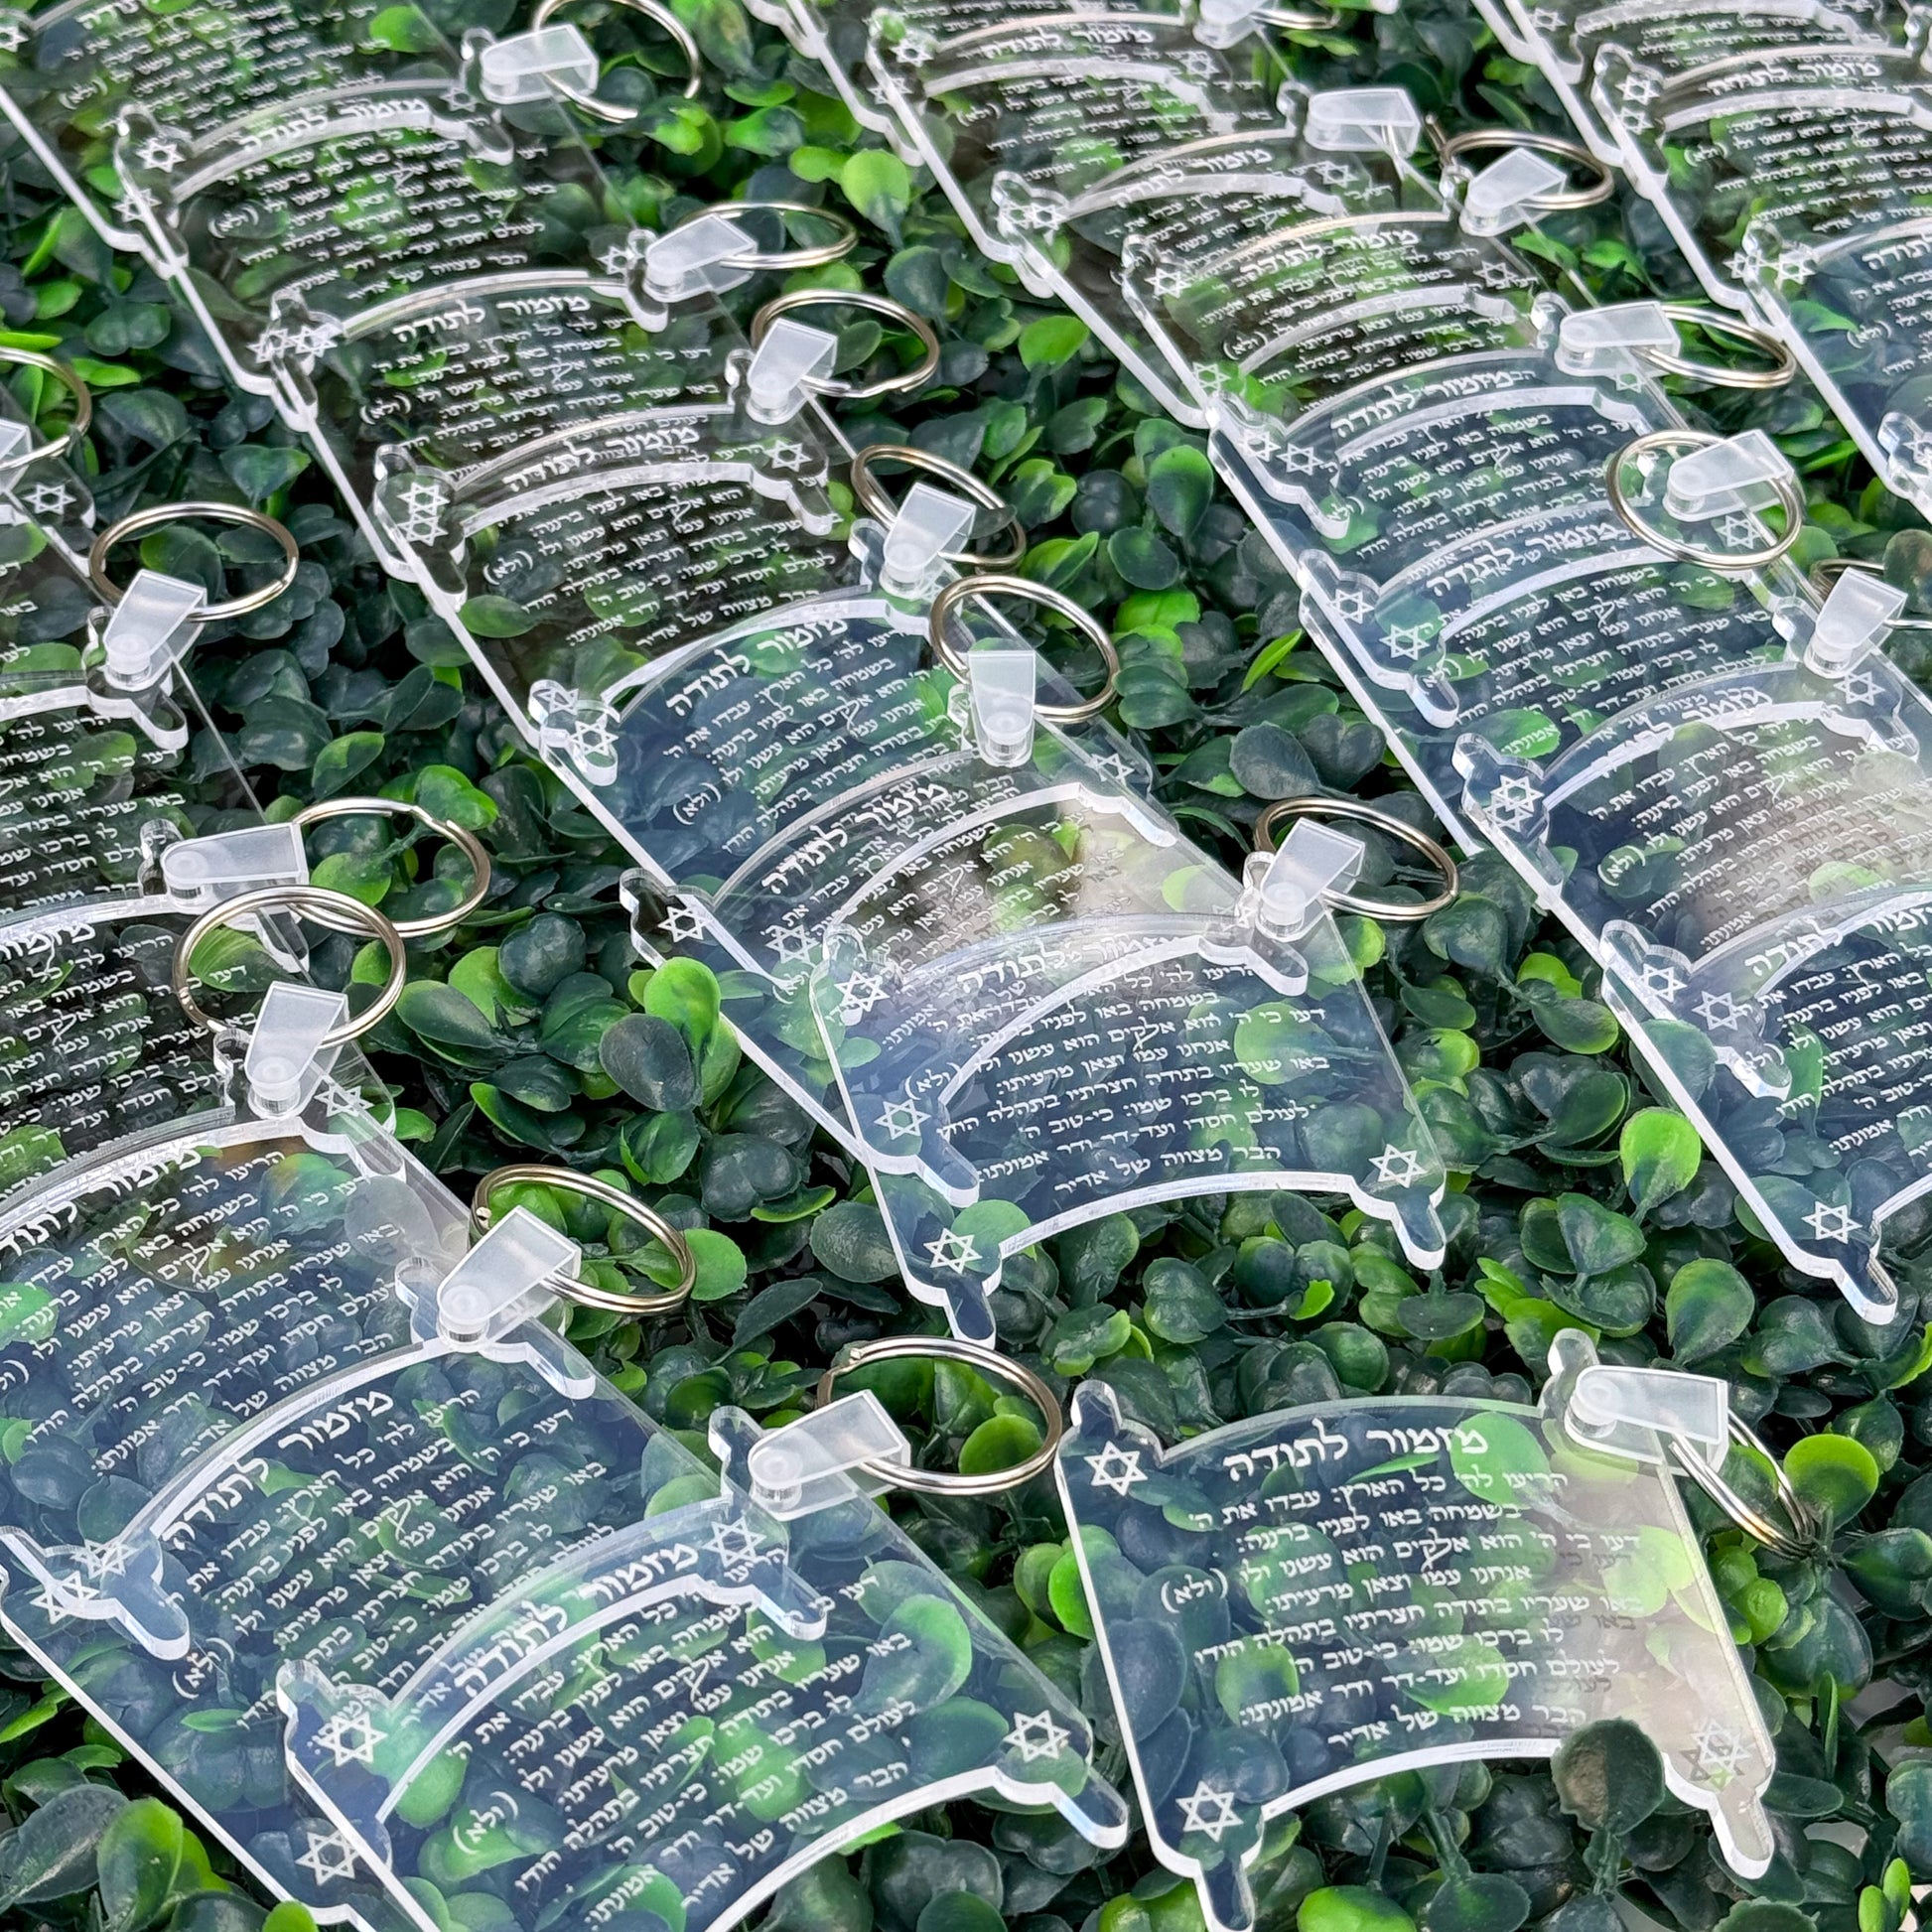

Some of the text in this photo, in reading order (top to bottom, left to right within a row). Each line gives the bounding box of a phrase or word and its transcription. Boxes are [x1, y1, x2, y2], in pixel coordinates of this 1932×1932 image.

[1588, 565, 1660, 593] בשמחה
[1509, 593, 1551, 620] לפניו
[1553, 585, 1588, 604] באו
[664, 616, 849, 717] מזמור לתודה
[828, 657, 897, 692] בשמחה
[796, 686, 831, 708] באו
[52, 714, 111, 734] הריעו
[756, 700, 796, 731] לפניו
[1725, 730, 1760, 747] כל
[140, 749, 178, 764] דעו
[1634, 766, 1677, 794] עבדו
[74, 792, 185, 819] באו שעריו
[1607, 789, 1638, 813] את
[980, 841, 1015, 864] הוא
[985, 860, 1035, 889] אנחנו
[111, 934, 175, 959] הריעו
[49, 969, 137, 1005] בשמחה
[1837, 977, 1883, 1006] לפניו
[1886, 971, 1926, 990] באו
[100, 992, 141, 1015] הוא
[1817, 1003, 1904, 1041] הוא עשנו
[1132, 1046, 1169, 1062] עמו
[1174, 1038, 1231, 1058] אנחנו
[1079, 1052, 1125, 1080] וצאן
[986, 1055, 1329, 1123] באו שעריו בתודה חצרתיו בתהלה
[1774, 1063, 1886, 1117] בתהלה הודו
[233, 1238, 293, 1272] אנחנו
[192, 1267, 232, 1292] עמו
[317, 1272, 344, 1293] לו
[143, 1289, 192, 1327] וצאן
[263, 1289, 319, 1320] ברכו
[179, 1332, 394, 1458] הבר מצווה של אדיר
[418, 1388, 482, 1426] הריעו
[333, 1447, 377, 1470] כל
[1222, 1417, 1489, 1482] מזמור לתודה
[160, 1390, 394, 1552] מזמור לתודה
[1408, 1467, 1448, 1493] כל
[1501, 1472, 1569, 1489] הריעו
[1220, 1501, 1259, 1526] את
[1263, 1489, 1321, 1513] עבדו
[1428, 1502, 1524, 1523] בשמחה
[1315, 1505, 1371, 1539] לפניו
[1379, 1507, 1424, 1528] באו
[218, 1518, 273, 1561] עבדו
[1479, 1533, 1523, 1551] הוא
[1565, 1533, 1591, 1549] כי
[1598, 1534, 1641, 1551] דעו
[1278, 1552, 1332, 1579] עשנו
[1340, 1544, 1386, 1566] הוא
[184, 1560, 223, 1594] את
[577, 1543, 700, 1602] מזמור
[1239, 1557, 1272, 1584] ולו
[1420, 1569, 1461, 1587] עמו
[1468, 1565, 1533, 1586] אנחנו
[1360, 1573, 1412, 1603] וצאן
[1193, 1595, 1644, 1665] באו שעריו בתודה חצרתיו בתהלה הודו
[1473, 1627, 1534, 1648] ברכו
[1539, 1616, 1565, 1644] לו
[734, 1650, 797, 1689] אנחנו
[1475, 1660, 1538, 1679] חסדו
[1545, 1648, 1621, 1678] לעולם
[690, 1684, 734, 1713] עמו
[824, 1690, 853, 1714] לו
[1329, 1679, 1375, 1700] ודר
[639, 1710, 690, 1754] וצאן
[767, 1710, 826, 1746] ברכו
[1326, 1703, 1587, 1748] הבר מצווה של אדיר
[513, 1631, 911, 1892] באו שעריו בתודה חצרתיו בתהלה הודו
[678, 1762, 908, 1910] הבר מצווה של אדיר
